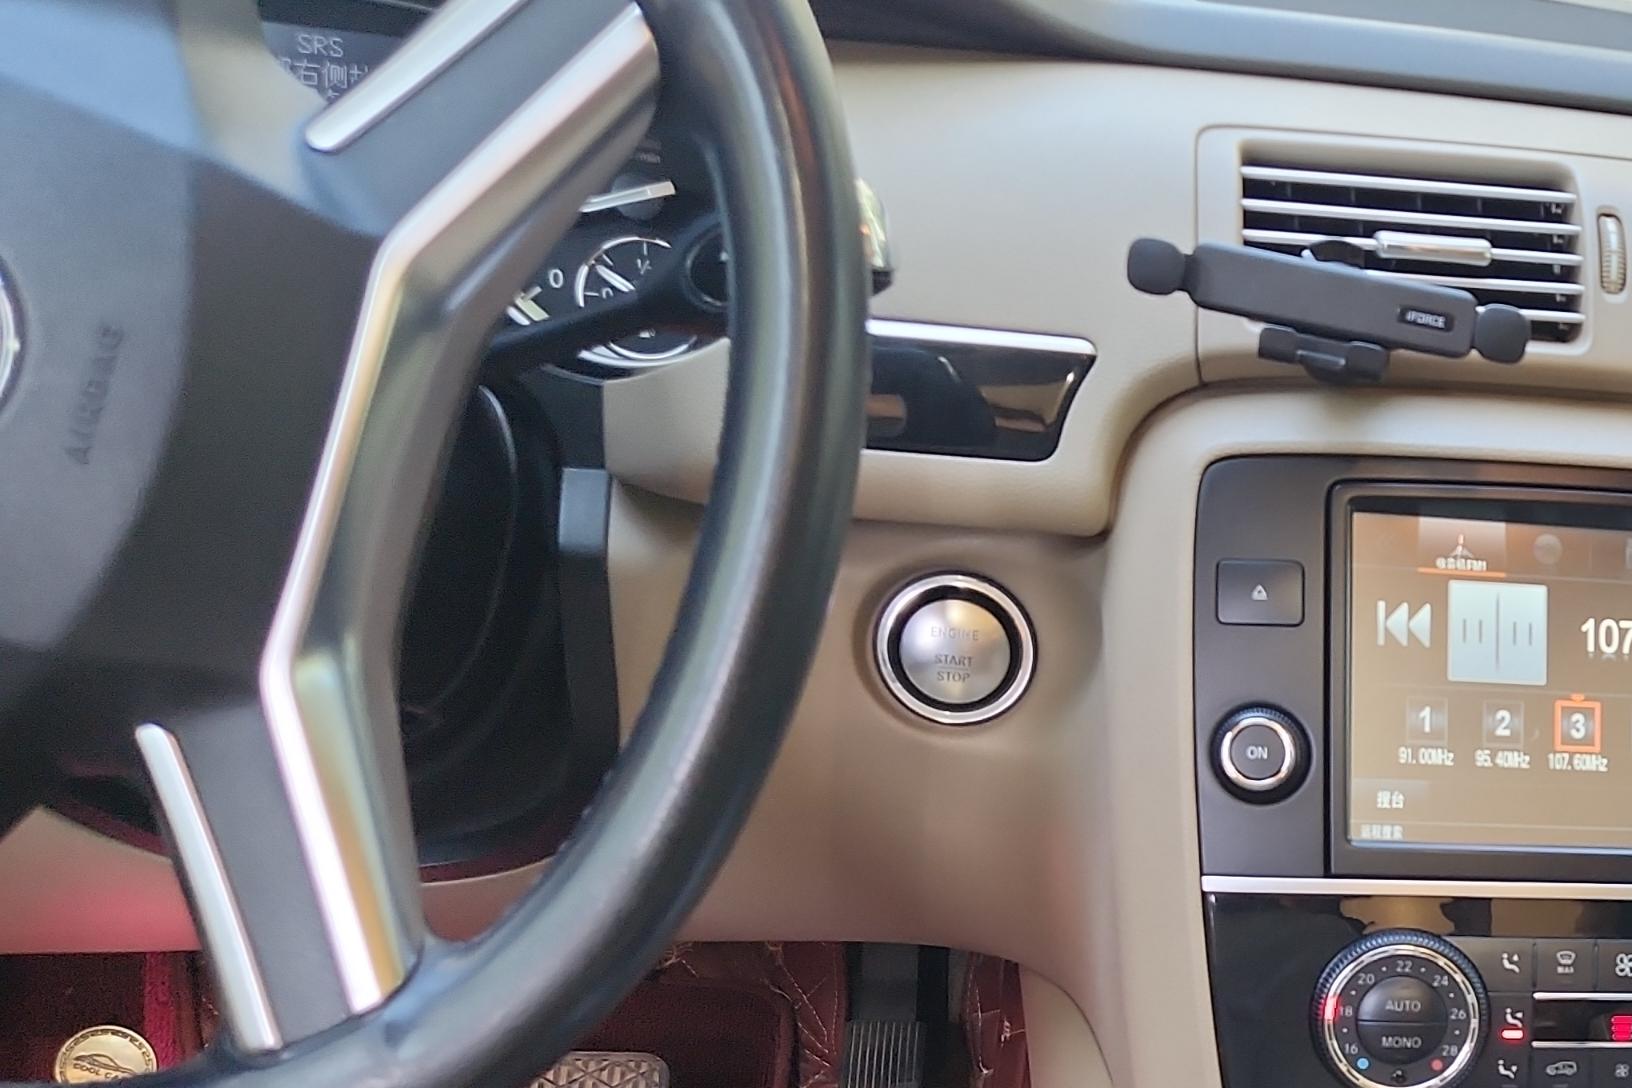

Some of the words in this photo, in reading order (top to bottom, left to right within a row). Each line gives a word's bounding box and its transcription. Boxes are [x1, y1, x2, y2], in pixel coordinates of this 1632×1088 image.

[297, 33, 344, 58] SRS
[934, 654, 974, 668] START
[936, 671, 972, 683] STOP
[1418, 706, 1432, 733] 1
[1495, 709, 1512, 737] 2
[1570, 712, 1586, 740] 3
[1246, 745, 1268, 760] ON
[1395, 960, 1413, 973] 22
[1357, 973, 1376, 985] 20
[1432, 974, 1449, 987] 24
[1339, 1005, 1353, 1017] 18
[1385, 1000, 1422, 1012] AUTO
[1450, 1008, 1467, 1020] 26
[1344, 1043, 1359, 1055] 16
[1381, 1036, 1422, 1049] MONO
[1442, 1044, 1459, 1057] 28
[73, 1062, 103, 1077] COOL
